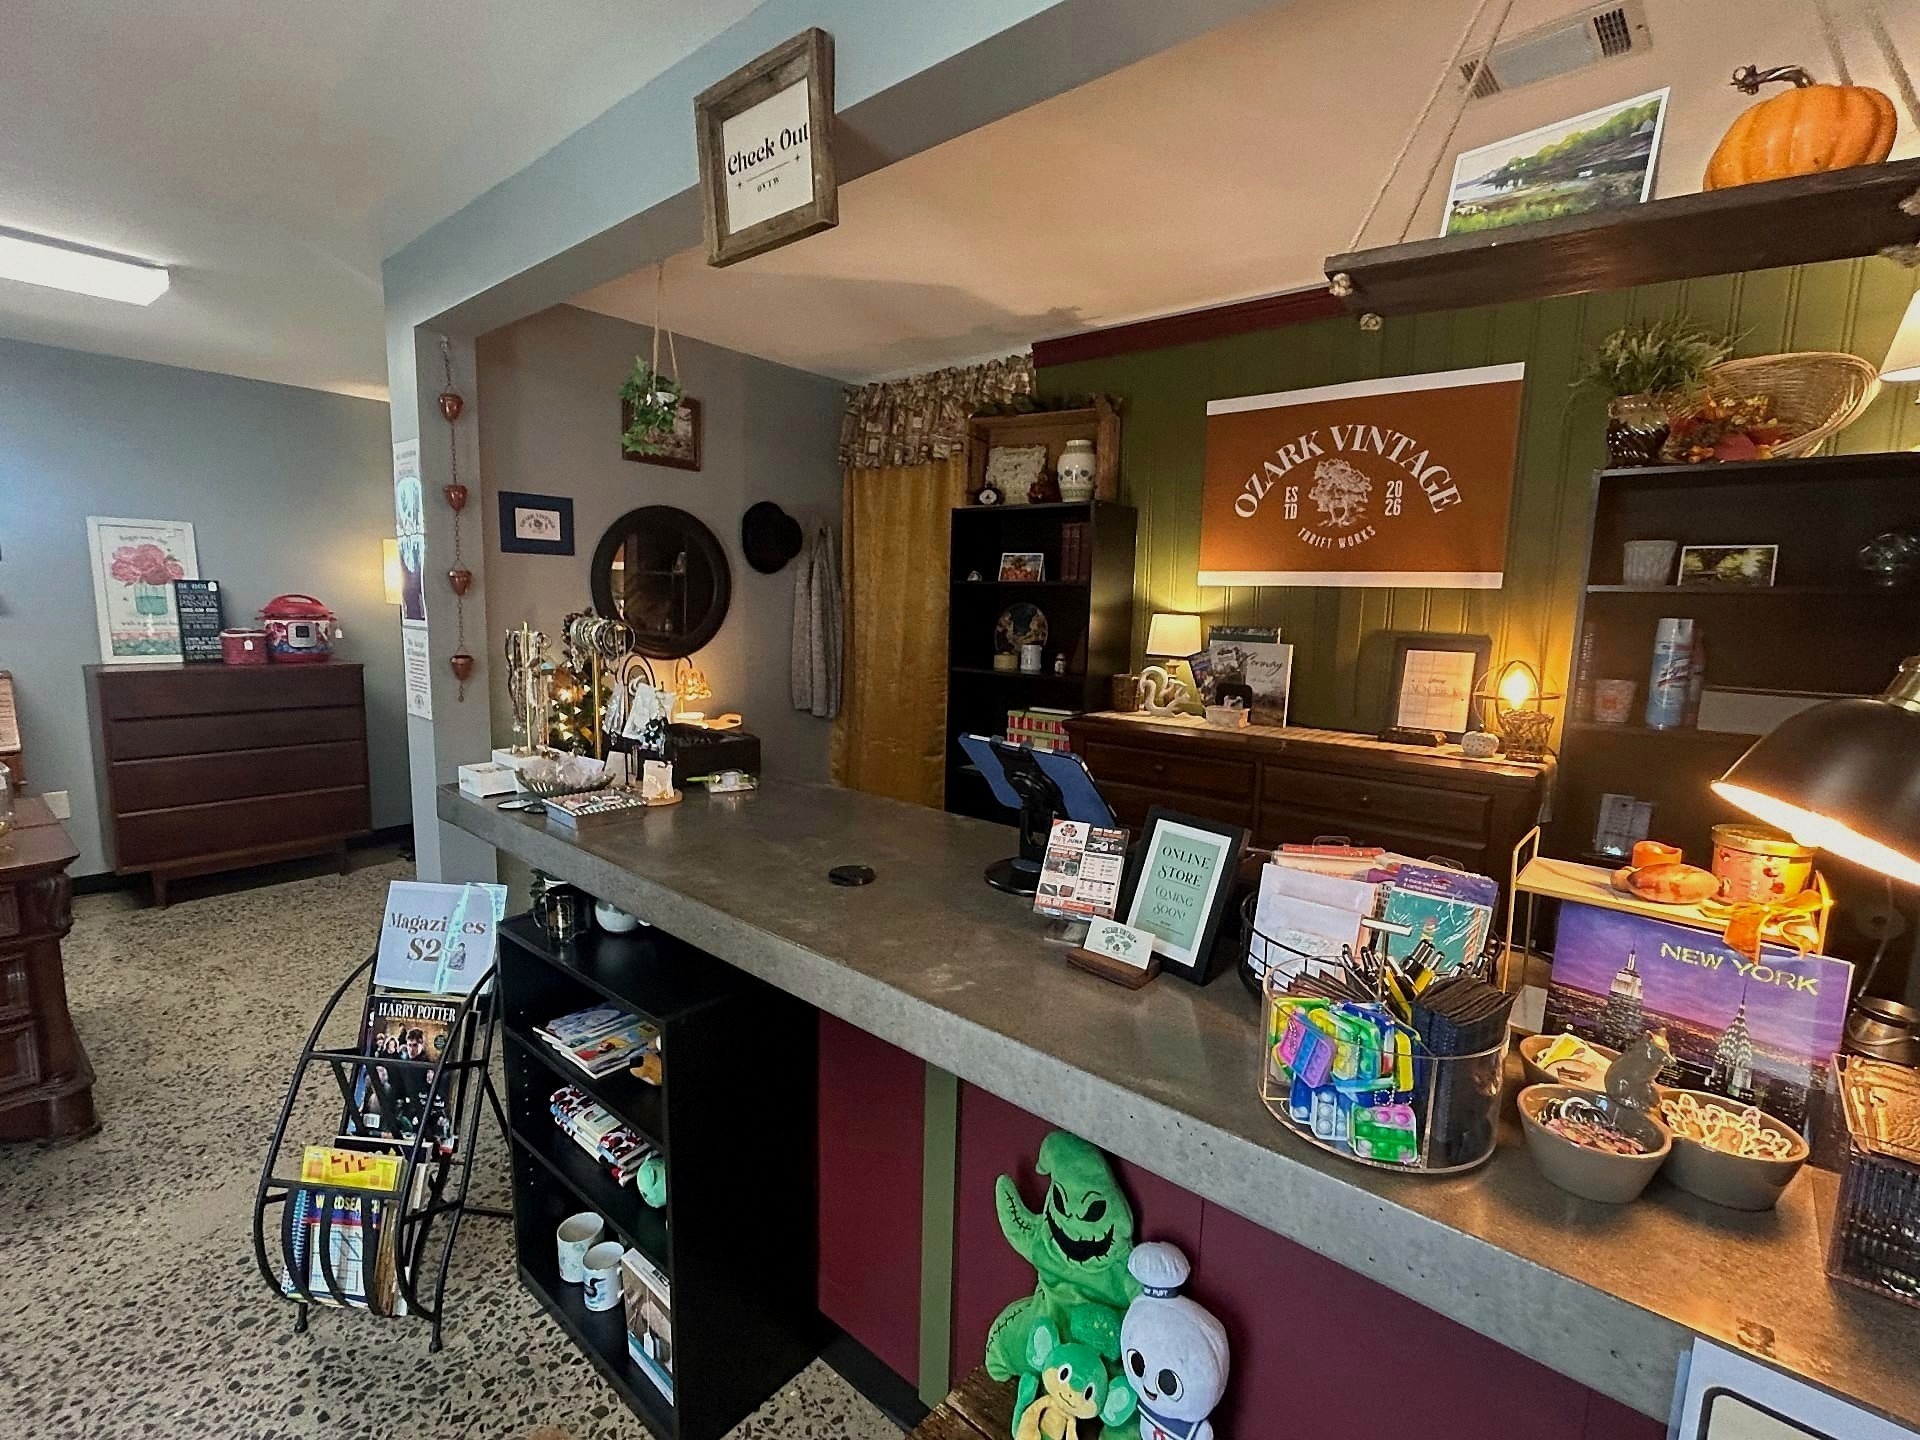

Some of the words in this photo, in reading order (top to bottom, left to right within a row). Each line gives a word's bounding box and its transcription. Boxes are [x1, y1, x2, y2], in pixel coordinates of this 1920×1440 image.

[727, 137, 775, 176] Check
[1234, 430, 1325, 518] OZARK
[1329, 424, 1463, 514] VINTAGE
[1285, 486, 1299, 503] ES
[1386, 480, 1403, 498] 20
[1284, 503, 1298, 520] TD
[1384, 498, 1401, 517] 26
[1297, 527, 1333, 550] THRIFT
[1338, 525, 1376, 549] WORKS
[1162, 845, 1212, 870] ONLINE
[1158, 864, 1203, 887] STORE
[1155, 884, 1194, 908] COMING
[389, 912, 487, 935] Magazies
[1153, 903, 1187, 921] SOON!
[1660, 942, 1724, 970] NEW
[1731, 958, 1820, 996] YORK
[378, 1002, 417, 1018] HARRY
[417, 1005, 457, 1023] POTTER
